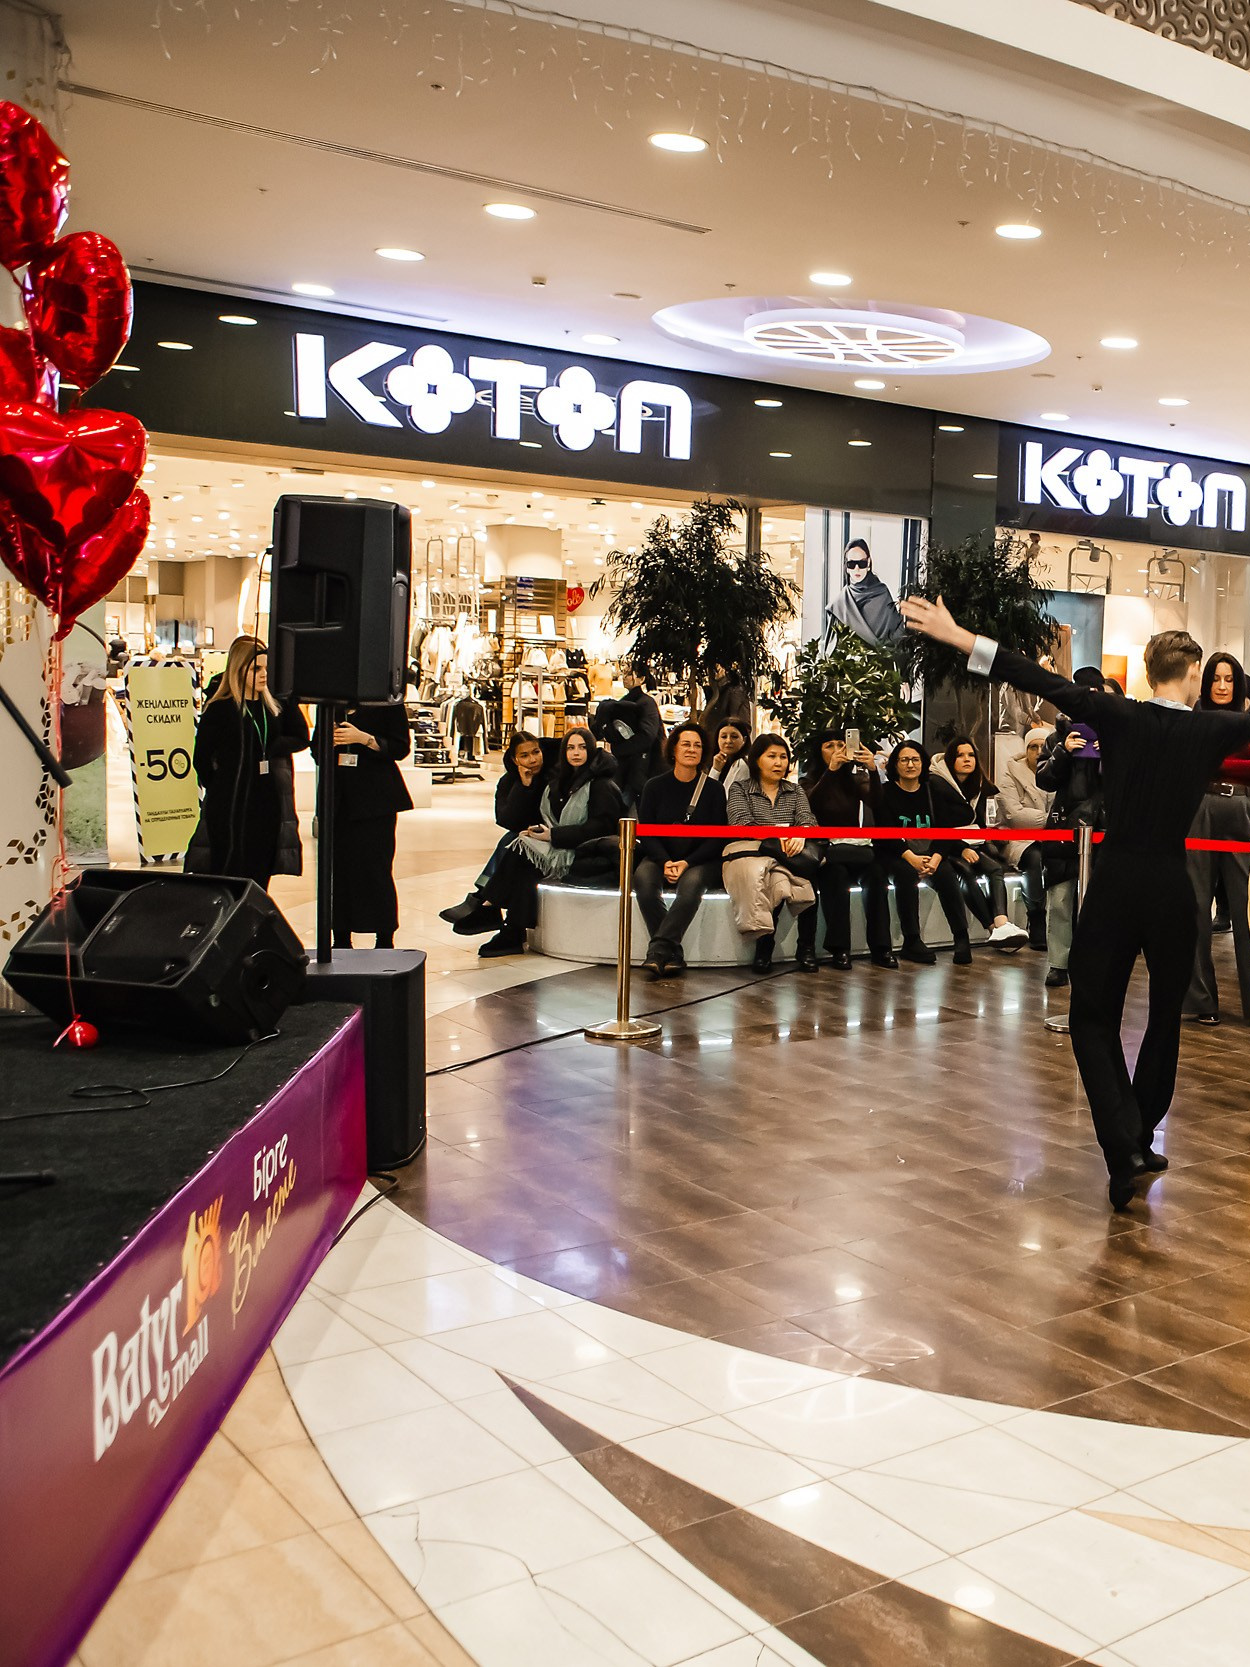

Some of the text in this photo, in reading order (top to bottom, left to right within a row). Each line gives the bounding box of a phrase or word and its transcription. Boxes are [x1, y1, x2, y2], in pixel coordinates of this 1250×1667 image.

[137, 699, 189, 709] ЖЕҢІЛДІКТЕР
[146, 714, 182, 724] СКИДКИ
[254, 1133, 288, 1201] Бірге
[228, 1158, 297, 1330] Вместе
[92, 1278, 184, 1462] Batyr
[172, 1314, 209, 1401] mall
